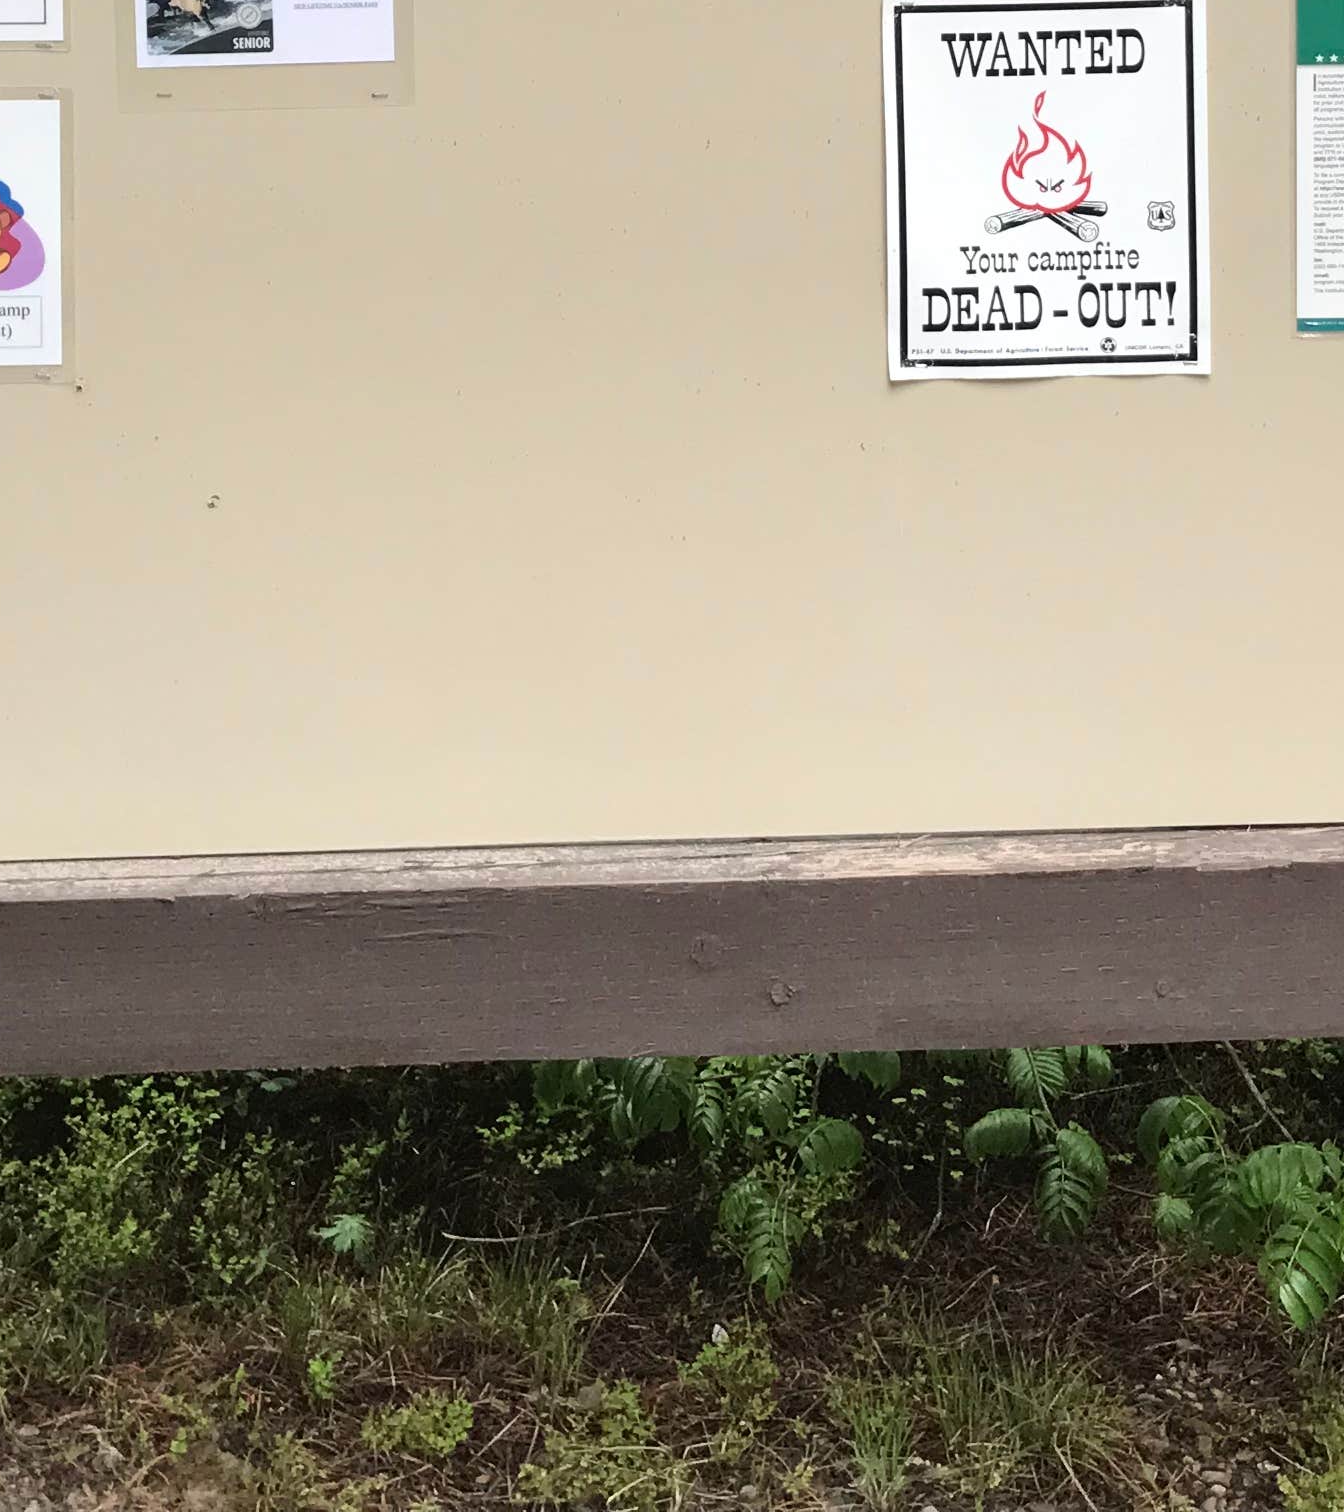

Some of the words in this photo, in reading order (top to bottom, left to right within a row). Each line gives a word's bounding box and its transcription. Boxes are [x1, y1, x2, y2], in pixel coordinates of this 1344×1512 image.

[232, 37, 271, 49] SENIOR
[940, 28, 1144, 77] WANTED
[959, 245, 1018, 274] Your
[1027, 243, 1139, 280] campfire
